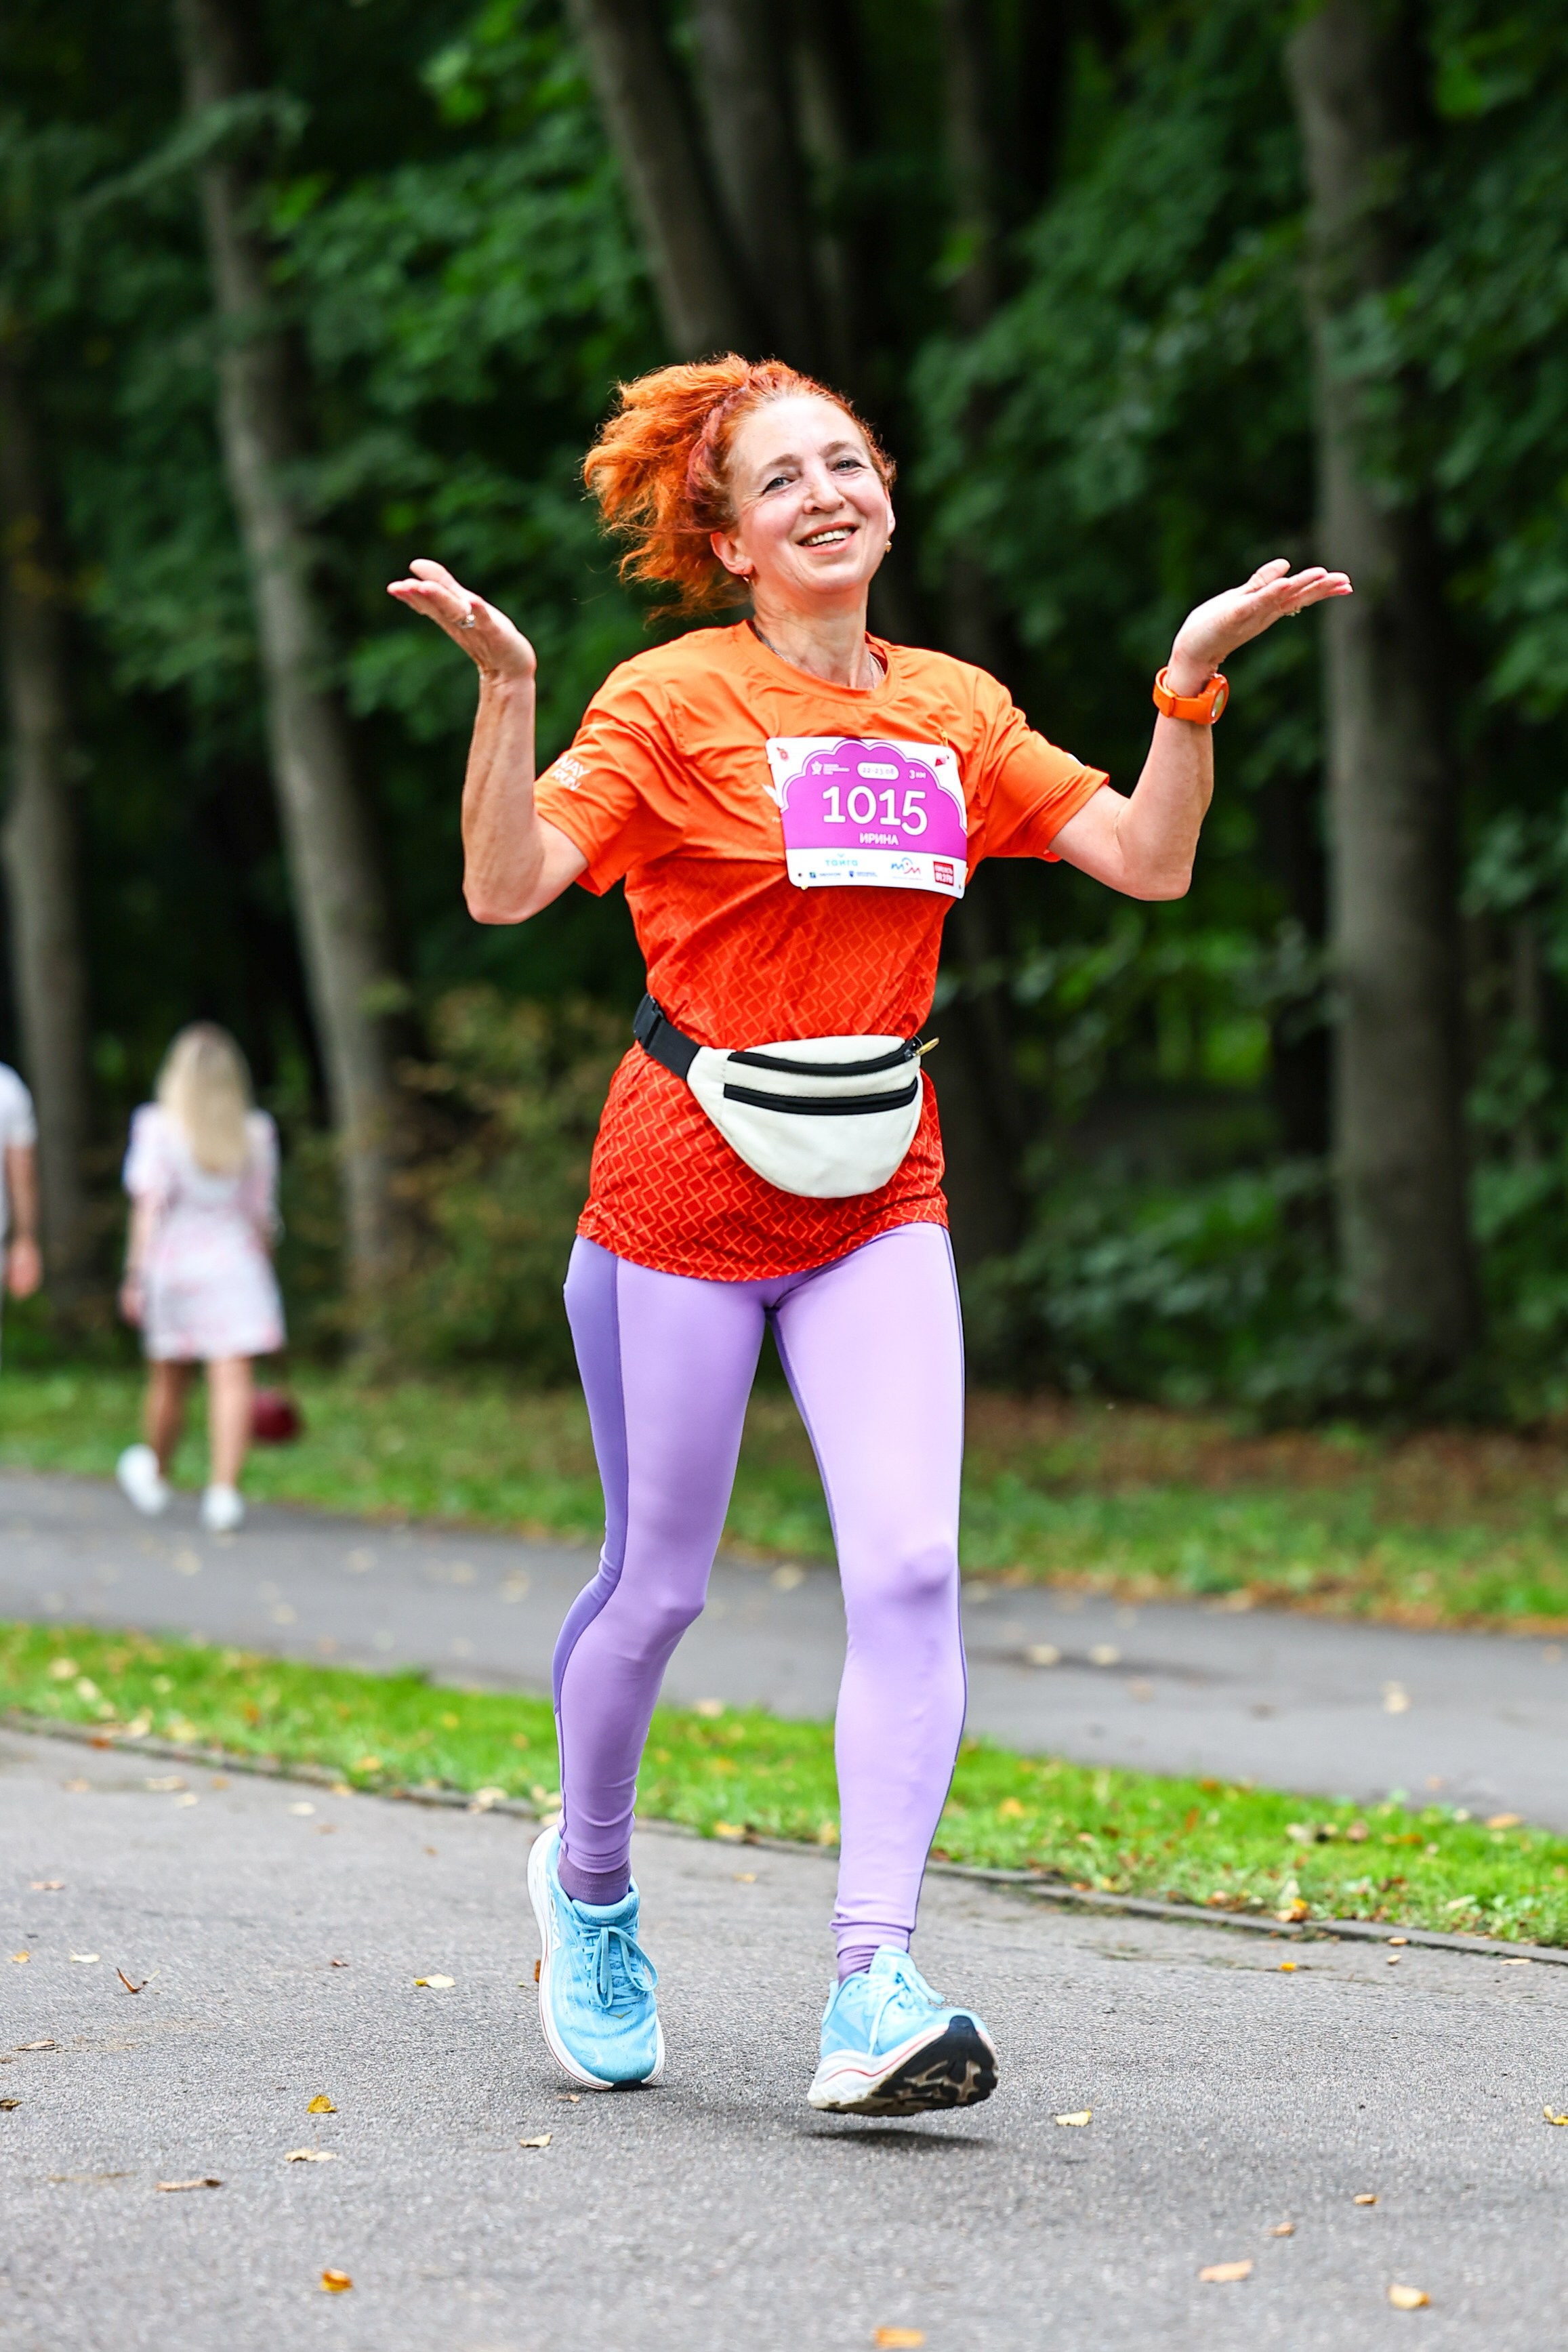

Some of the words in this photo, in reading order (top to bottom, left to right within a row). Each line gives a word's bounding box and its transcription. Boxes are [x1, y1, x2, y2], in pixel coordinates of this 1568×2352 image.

[551, 768, 581, 791] RUN
[822, 785, 928, 836] 1015
[859, 832, 899, 846] ИРИНА
